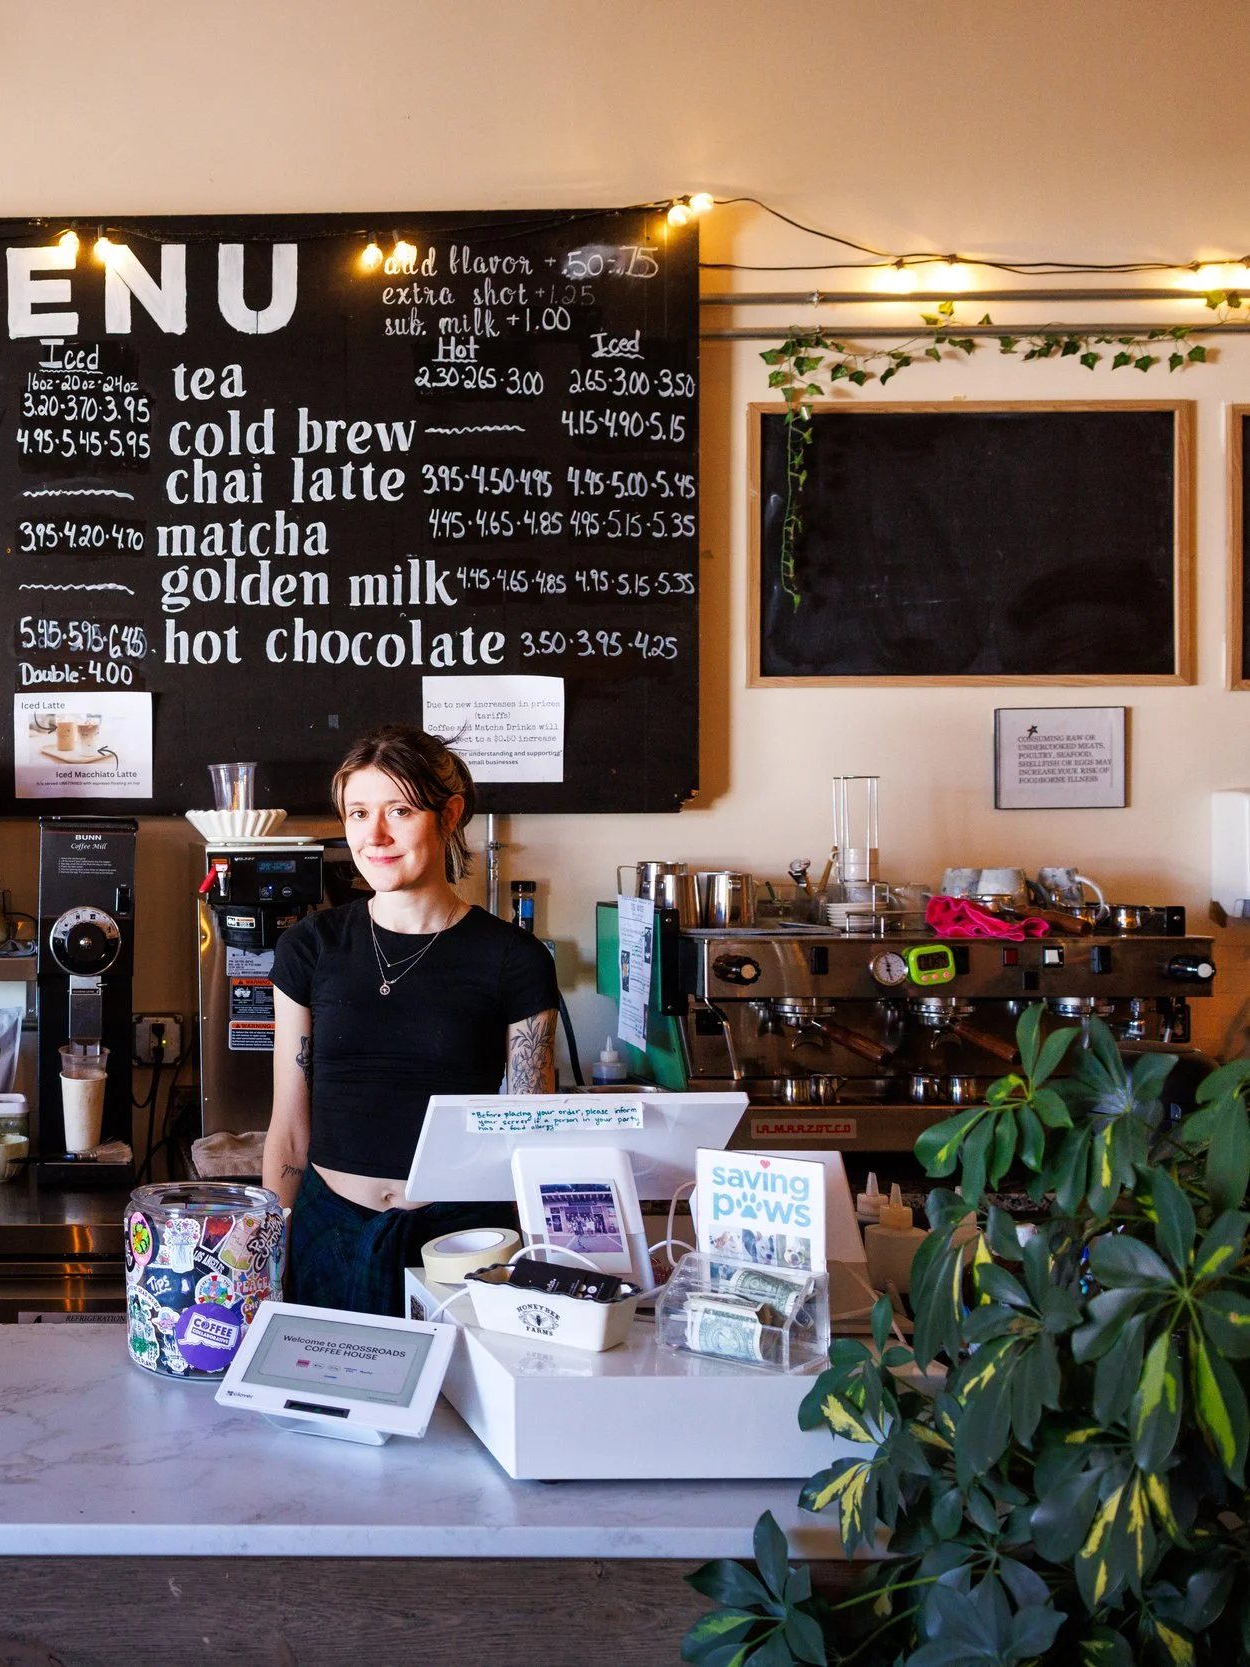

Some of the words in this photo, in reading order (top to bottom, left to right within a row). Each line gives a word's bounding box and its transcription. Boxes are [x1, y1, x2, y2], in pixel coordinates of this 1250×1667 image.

[450, 245, 533, 275] flavor
[382, 282, 455, 305] extra
[474, 278, 528, 305] shot
[439, 308, 500, 337] milk
[437, 336, 480, 358] Hot
[591, 329, 641, 355] Iced
[39, 339, 101, 370] Iced
[172, 363, 247, 401] tea
[169, 408, 276, 456] cold
[298, 407, 416, 454] brew
[166, 459, 263, 504] chai
[291, 458, 405, 504] latte
[156, 510, 329, 556] matcha
[161, 558, 330, 613] golden
[349, 559, 457, 606] milk
[164, 619, 242, 664] hot
[266, 617, 506, 668] chocolate
[88, 660, 133, 685] 4.00
[532, 701, 560, 709] prices
[428, 724, 454, 732] Coffee
[1017, 735, 1064, 743] CONSUMING
[1018, 743, 1076, 751] UNDERCOOKED
[469, 750, 513, 758] understanding
[56, 771, 73, 779] Iced
[1018, 768, 1056, 776] INCREASE
[71, 843, 91, 851] Coffee
[504, 1111, 532, 1121] placing
[585, 1107, 608, 1116] please
[554, 1117, 578, 1126] person
[595, 1117, 612, 1126] your
[618, 1116, 640, 1125] party
[712, 1164, 810, 1201] saving
[65, 1315, 126, 1323] REFRIGERATION
[193, 1318, 233, 1338] COFFEE
[192, 1328, 230, 1345] COLLABORATIVE
[283, 1335, 325, 1347] Welcome
[338, 1343, 406, 1358] CROSSROADS
[305, 1345, 342, 1356] COFFEE
[343, 1351, 378, 1361] HOUSE
